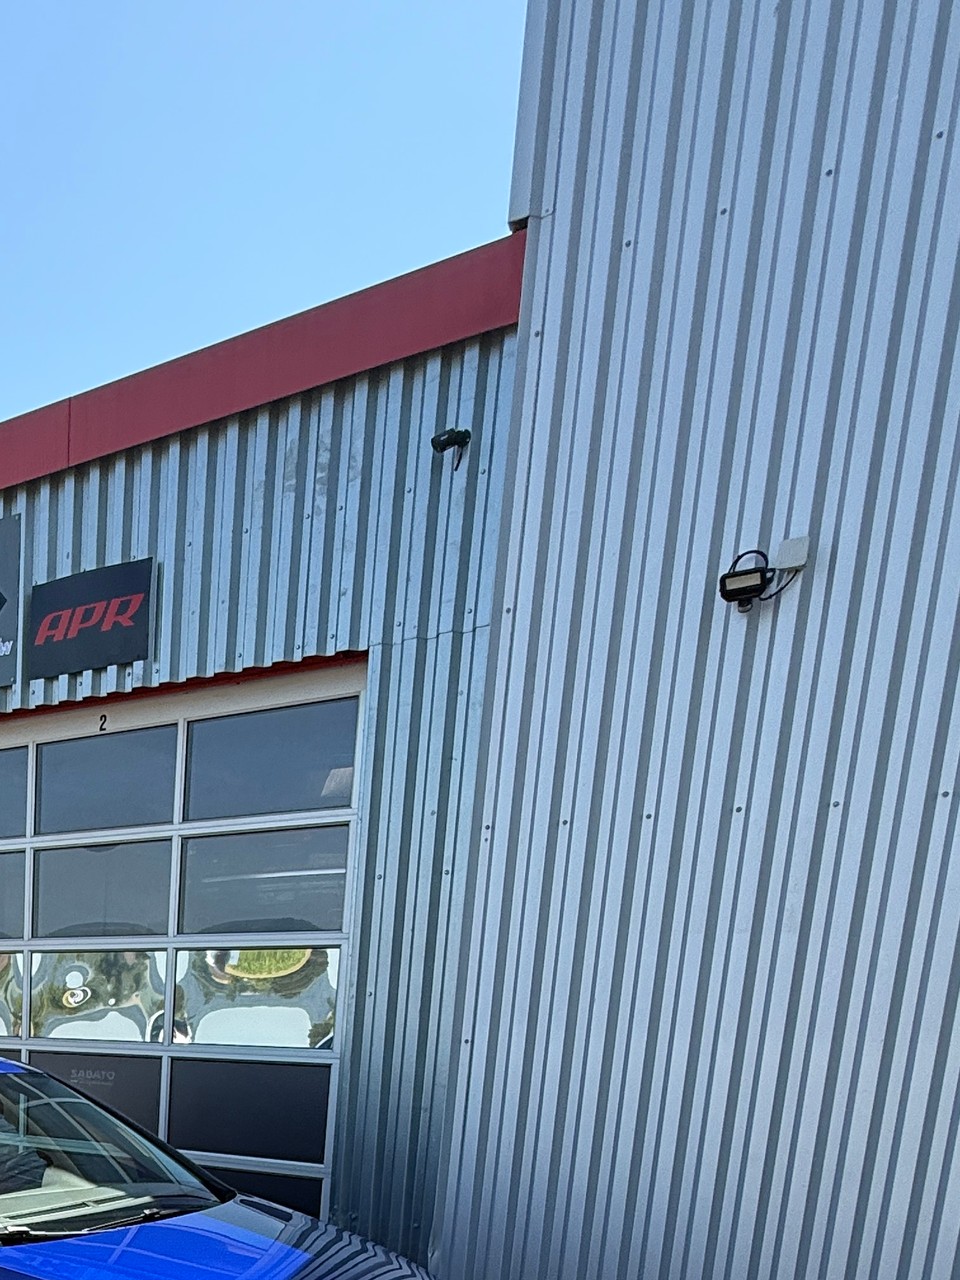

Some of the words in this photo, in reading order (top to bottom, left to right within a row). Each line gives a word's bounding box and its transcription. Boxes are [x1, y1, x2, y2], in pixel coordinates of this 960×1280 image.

[34, 593, 144, 646] APR
[99, 714, 107, 731] 2
[70, 1069, 115, 1080] SABATO
